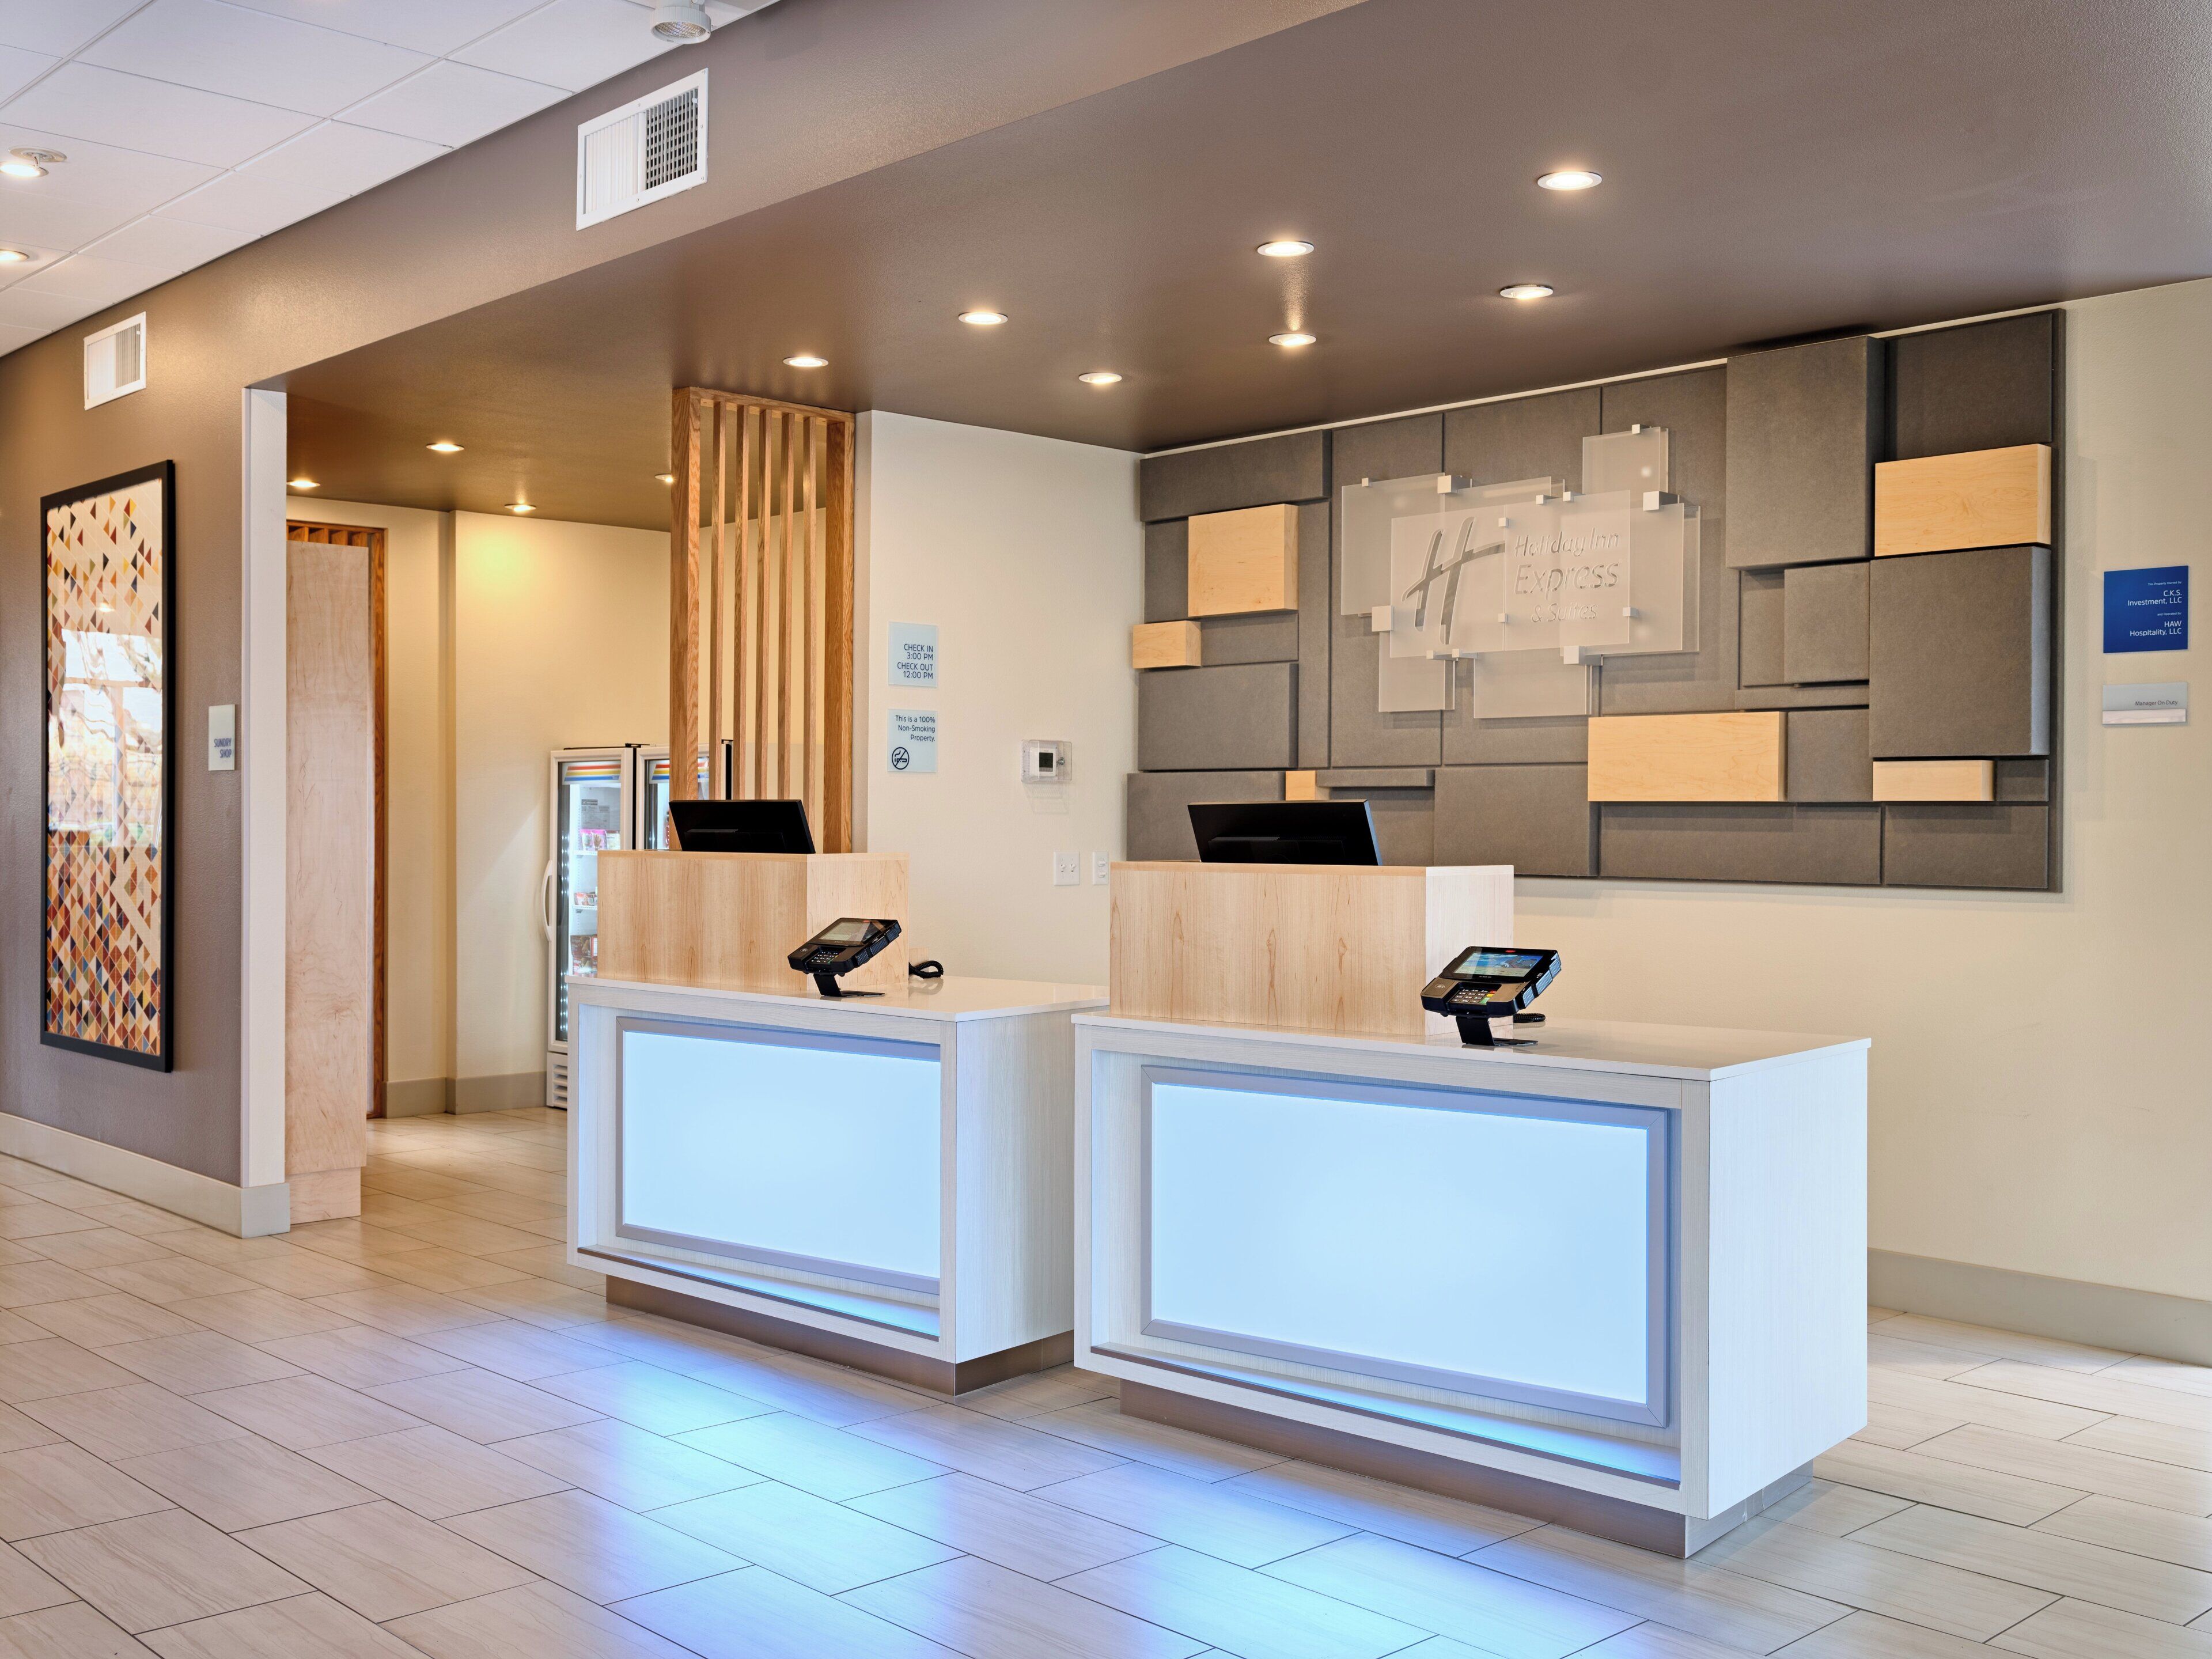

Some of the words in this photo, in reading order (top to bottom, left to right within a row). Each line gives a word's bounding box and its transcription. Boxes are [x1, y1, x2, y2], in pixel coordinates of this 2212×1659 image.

[1514, 531, 1585, 557] Holiday
[1590, 527, 1619, 550] Inn
[1514, 562, 1619, 600] Express
[2127, 598, 2168, 606] Investment,
[1531, 605, 1543, 623] &
[1547, 603, 1597, 622] Suites
[2130, 628, 2167, 637] Hospitality,
[904, 643, 925, 652] CHECK
[906, 652, 922, 660] 3:00
[897, 662, 918, 670] CHECK
[920, 663, 933, 671] OUT
[903, 671, 922, 679] 12:00
[898, 724, 935, 733] Non-Smoking
[910, 734, 935, 742] Property.
[214, 738, 232, 748] SUNDRY
[219, 749, 232, 758] SHOP
